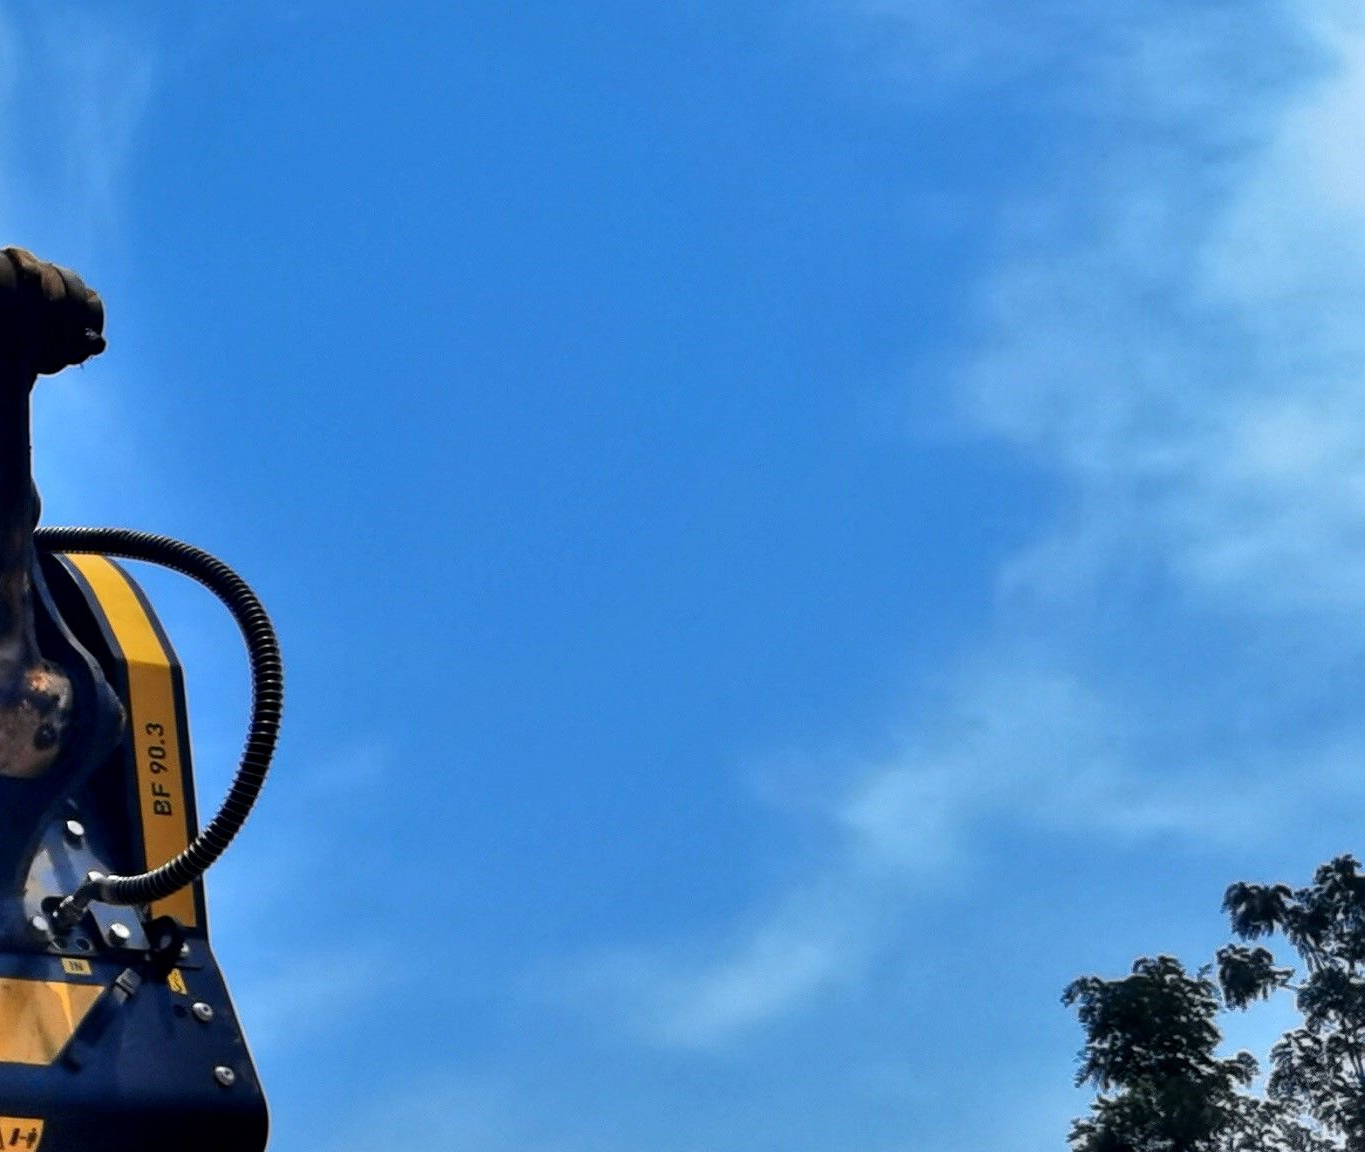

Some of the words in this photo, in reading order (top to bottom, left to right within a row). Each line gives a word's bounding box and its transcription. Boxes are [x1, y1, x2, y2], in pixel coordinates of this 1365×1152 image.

[145, 722, 169, 774] 90.3
[151, 781, 173, 817] BF
[68, 960, 84, 971] IN
